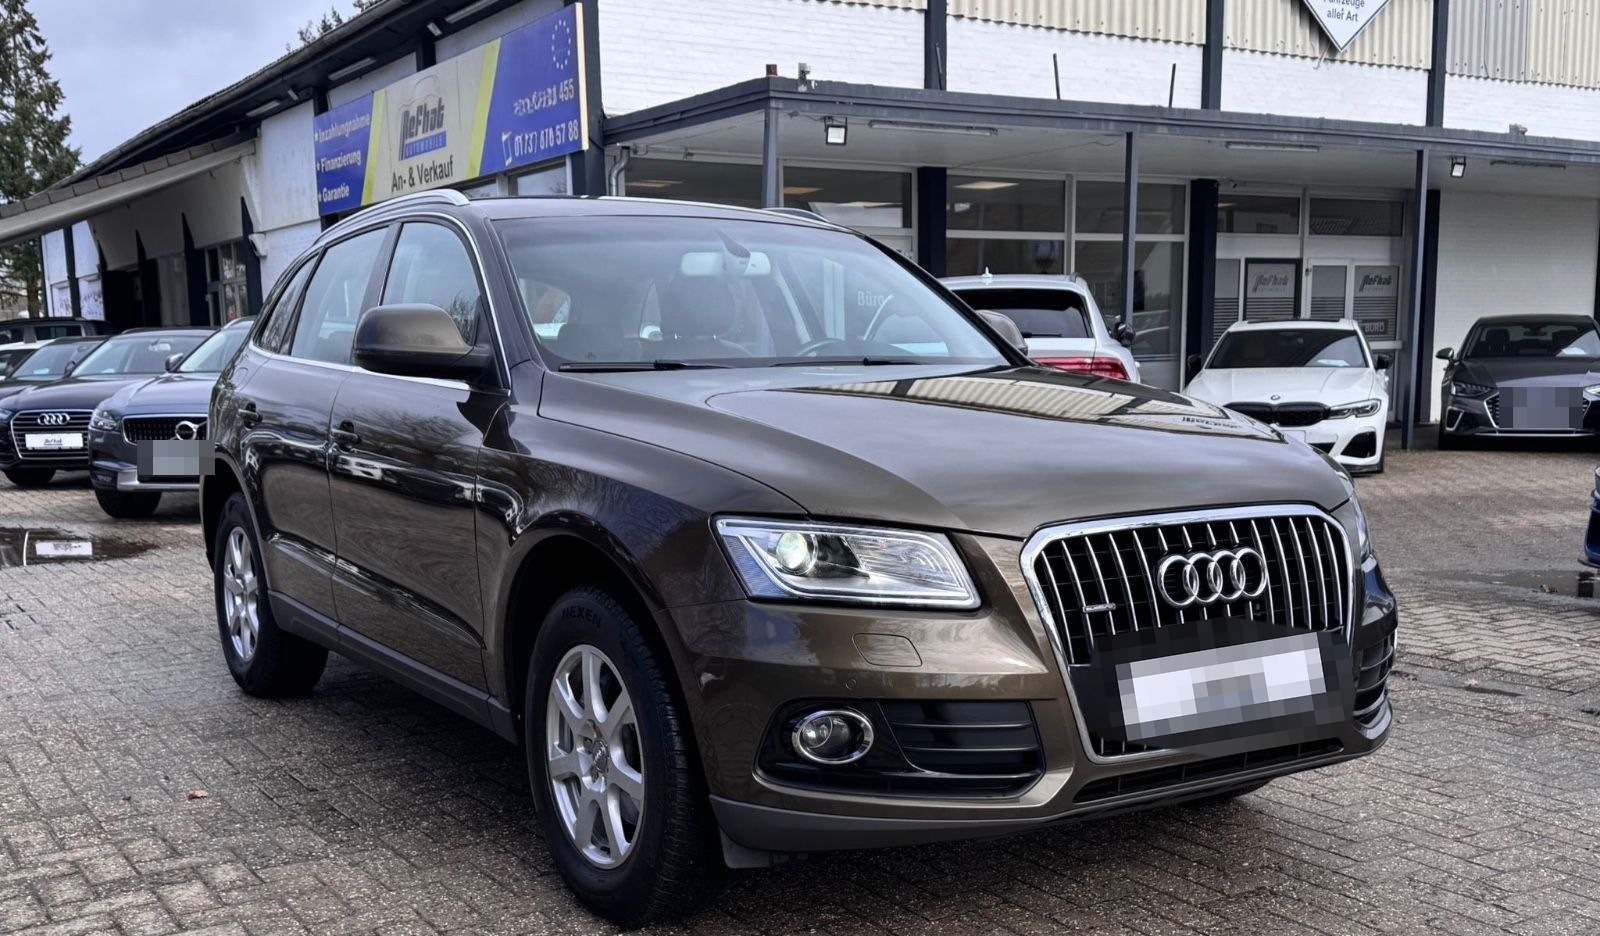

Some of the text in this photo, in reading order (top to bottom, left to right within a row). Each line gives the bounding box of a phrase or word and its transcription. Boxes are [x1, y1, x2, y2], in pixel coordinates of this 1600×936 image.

[1327, 8, 1358, 21] aller Art
[556, 122, 566, 145] 57
[568, 119, 579, 142] 88
[321, 150, 361, 173] Finanzierung
[392, 154, 454, 192] An- & Verkauf
[323, 182, 350, 203] Garantie
[562, 605, 602, 629] NEXEN
